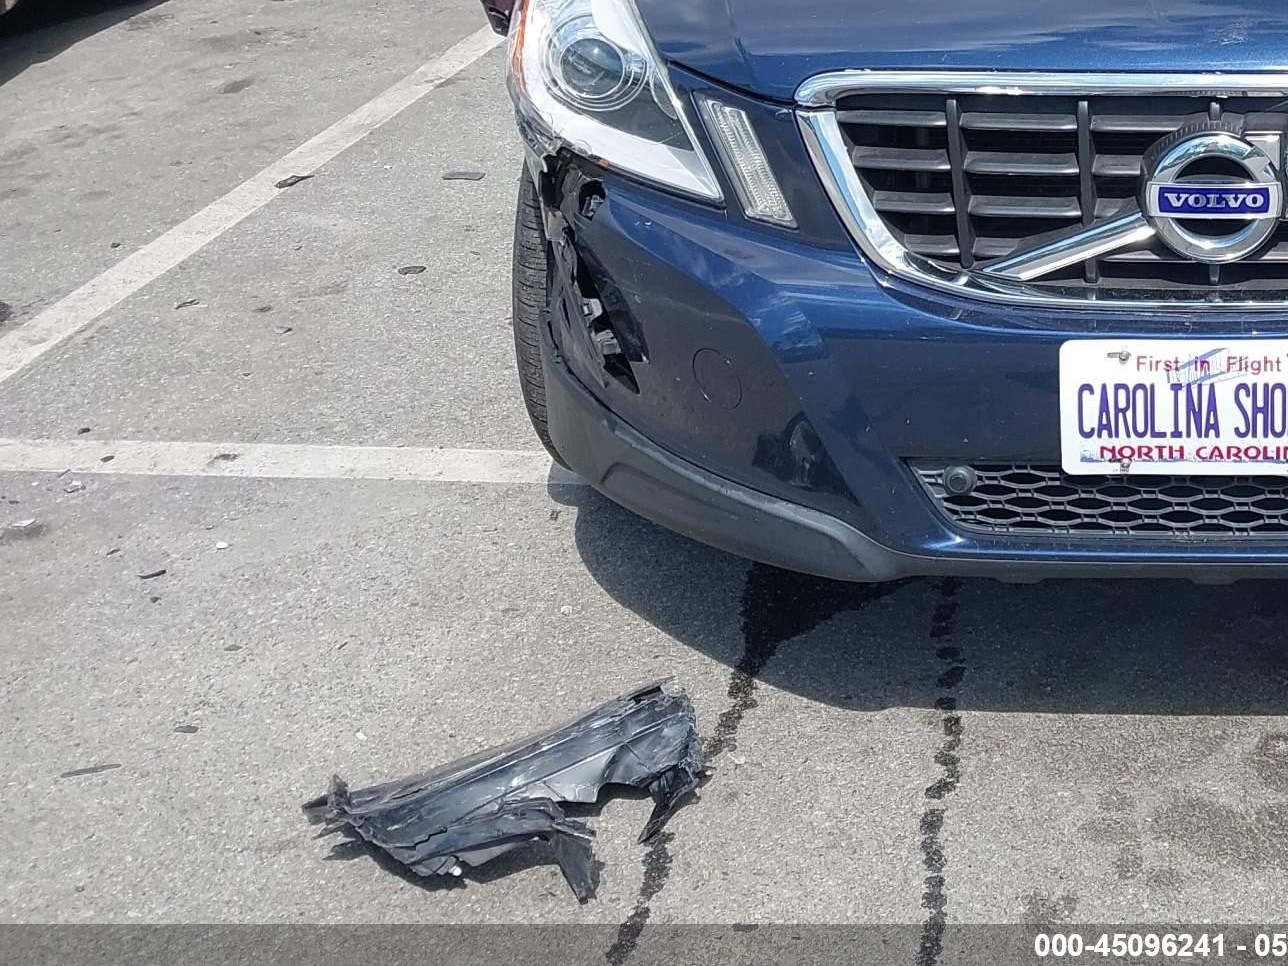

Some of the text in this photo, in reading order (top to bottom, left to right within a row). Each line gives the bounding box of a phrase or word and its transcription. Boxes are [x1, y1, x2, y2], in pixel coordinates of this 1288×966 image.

[1164, 193, 1264, 208] VOLVO
[1136, 355, 1282, 375] First in Flight
[1077, 383, 1221, 439] CAROLINA
[1099, 445, 1185, 460] NORTH
